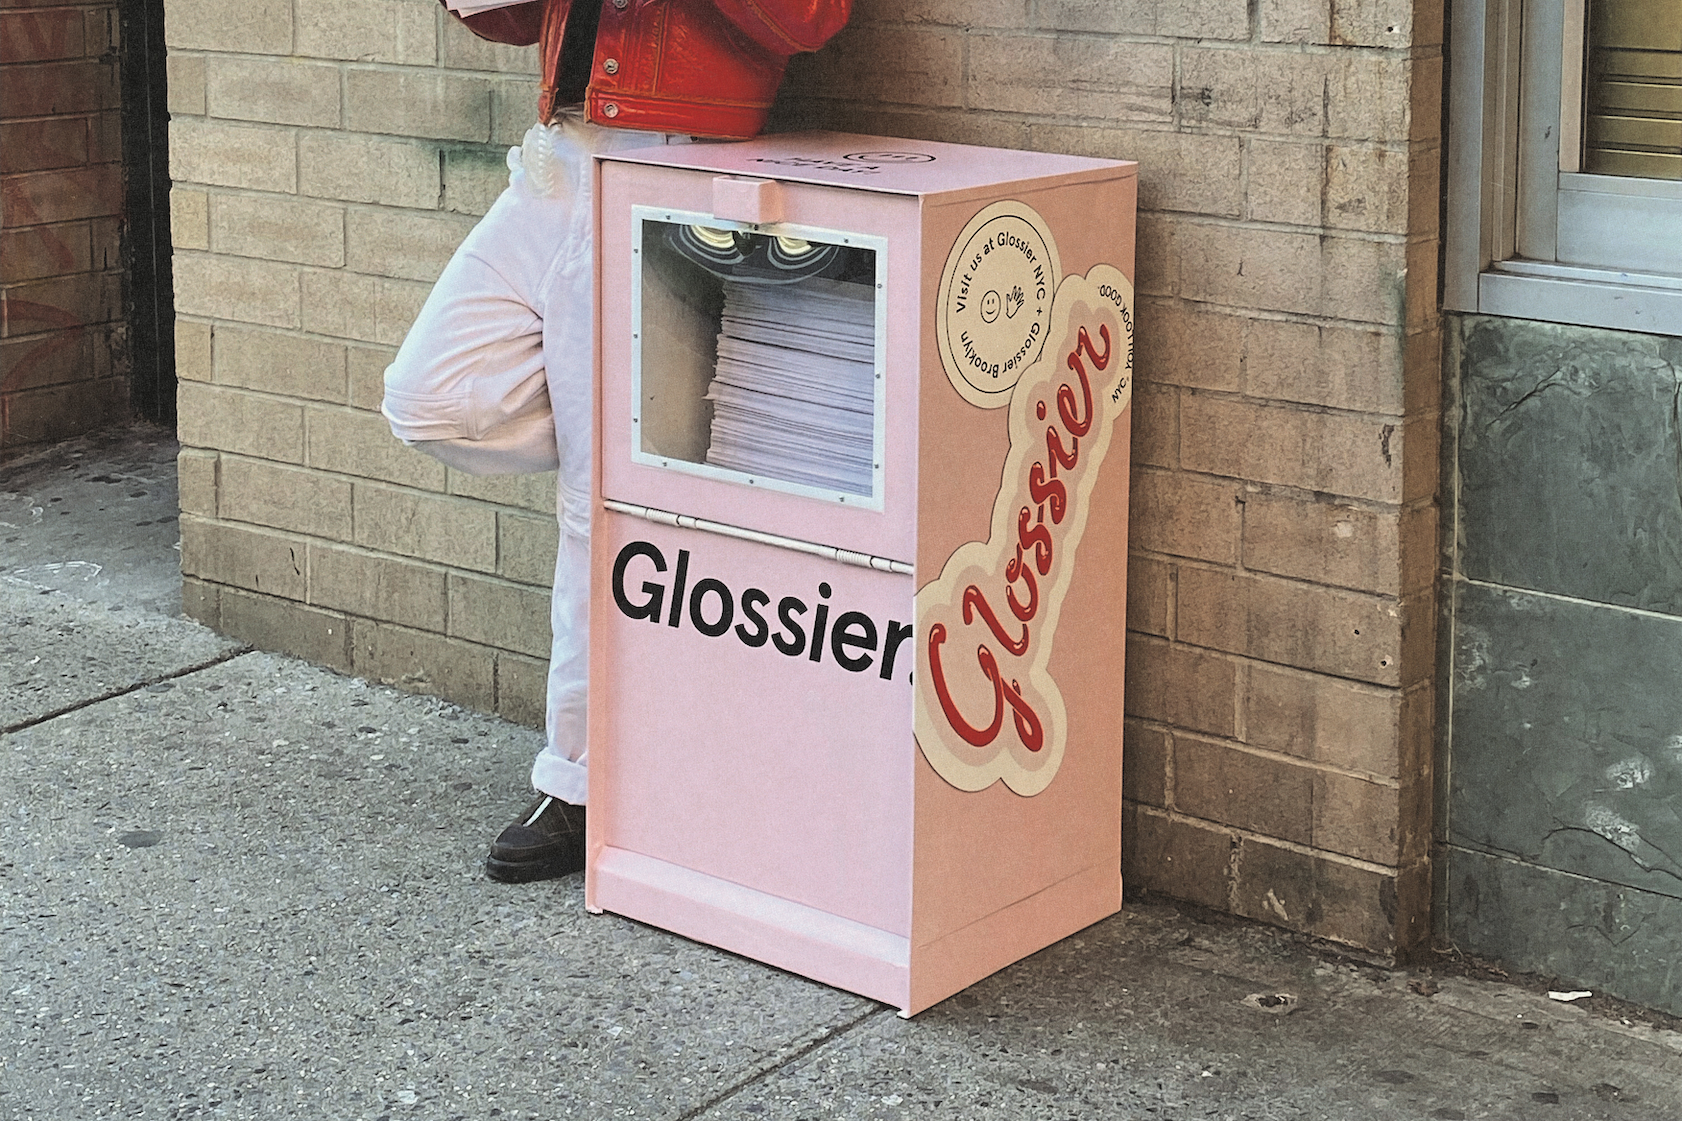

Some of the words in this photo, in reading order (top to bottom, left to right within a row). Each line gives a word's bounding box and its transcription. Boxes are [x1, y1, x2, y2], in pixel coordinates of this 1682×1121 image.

[970, 254, 983, 271] us
[982, 237, 995, 255] at
[997, 231, 1037, 264] Glossier
[956, 273, 973, 313] Visit
[1033, 264, 1046, 300] NYC
[1036, 306, 1043, 316] +
[960, 330, 999, 378] Brooklyn
[1002, 322, 1040, 374] Glossier
[928, 323, 1111, 752] Glossier
[612, 541, 914, 686] Glossier
